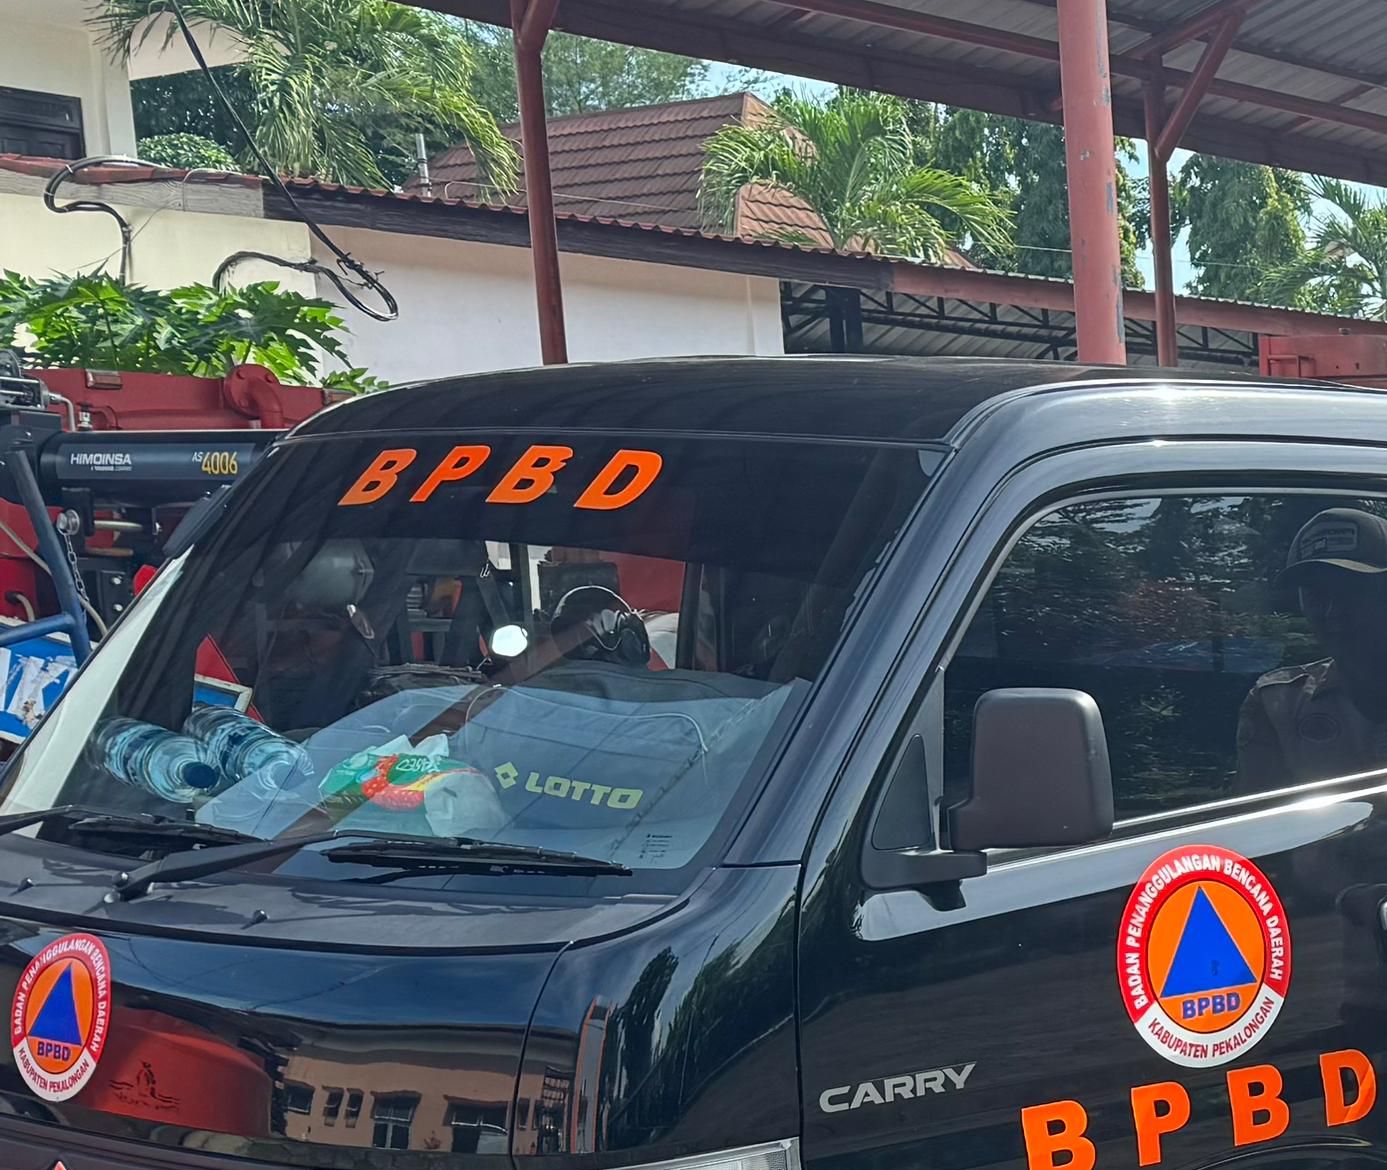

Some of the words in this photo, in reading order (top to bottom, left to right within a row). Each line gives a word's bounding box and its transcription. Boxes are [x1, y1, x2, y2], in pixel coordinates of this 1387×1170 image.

[70, 453, 132, 465] HIMOINSA
[192, 451, 203, 462] AS
[201, 452, 238, 474] 4006
[337, 445, 662, 510] BPBD
[525, 772, 644, 809] LOTTO
[1126, 854, 1220, 948] PENANGGULANGAN
[1223, 859, 1273, 917] BENCANA
[1265, 915, 1284, 981] DAERAH
[1126, 952, 1149, 1010] BADAN
[1182, 992, 1241, 1019] BPBD
[14, 994, 26, 1036] BADAN
[1148, 1017, 1208, 1059] KABUPATEN
[1211, 996, 1275, 1058] PEKALONGAN
[18, 1047, 48, 1090] KABUPATEN
[49, 1059, 90, 1093] PEKALONGAN
[37, 1042, 71, 1062] BPBD
[819, 1061, 977, 1113] CARRY
